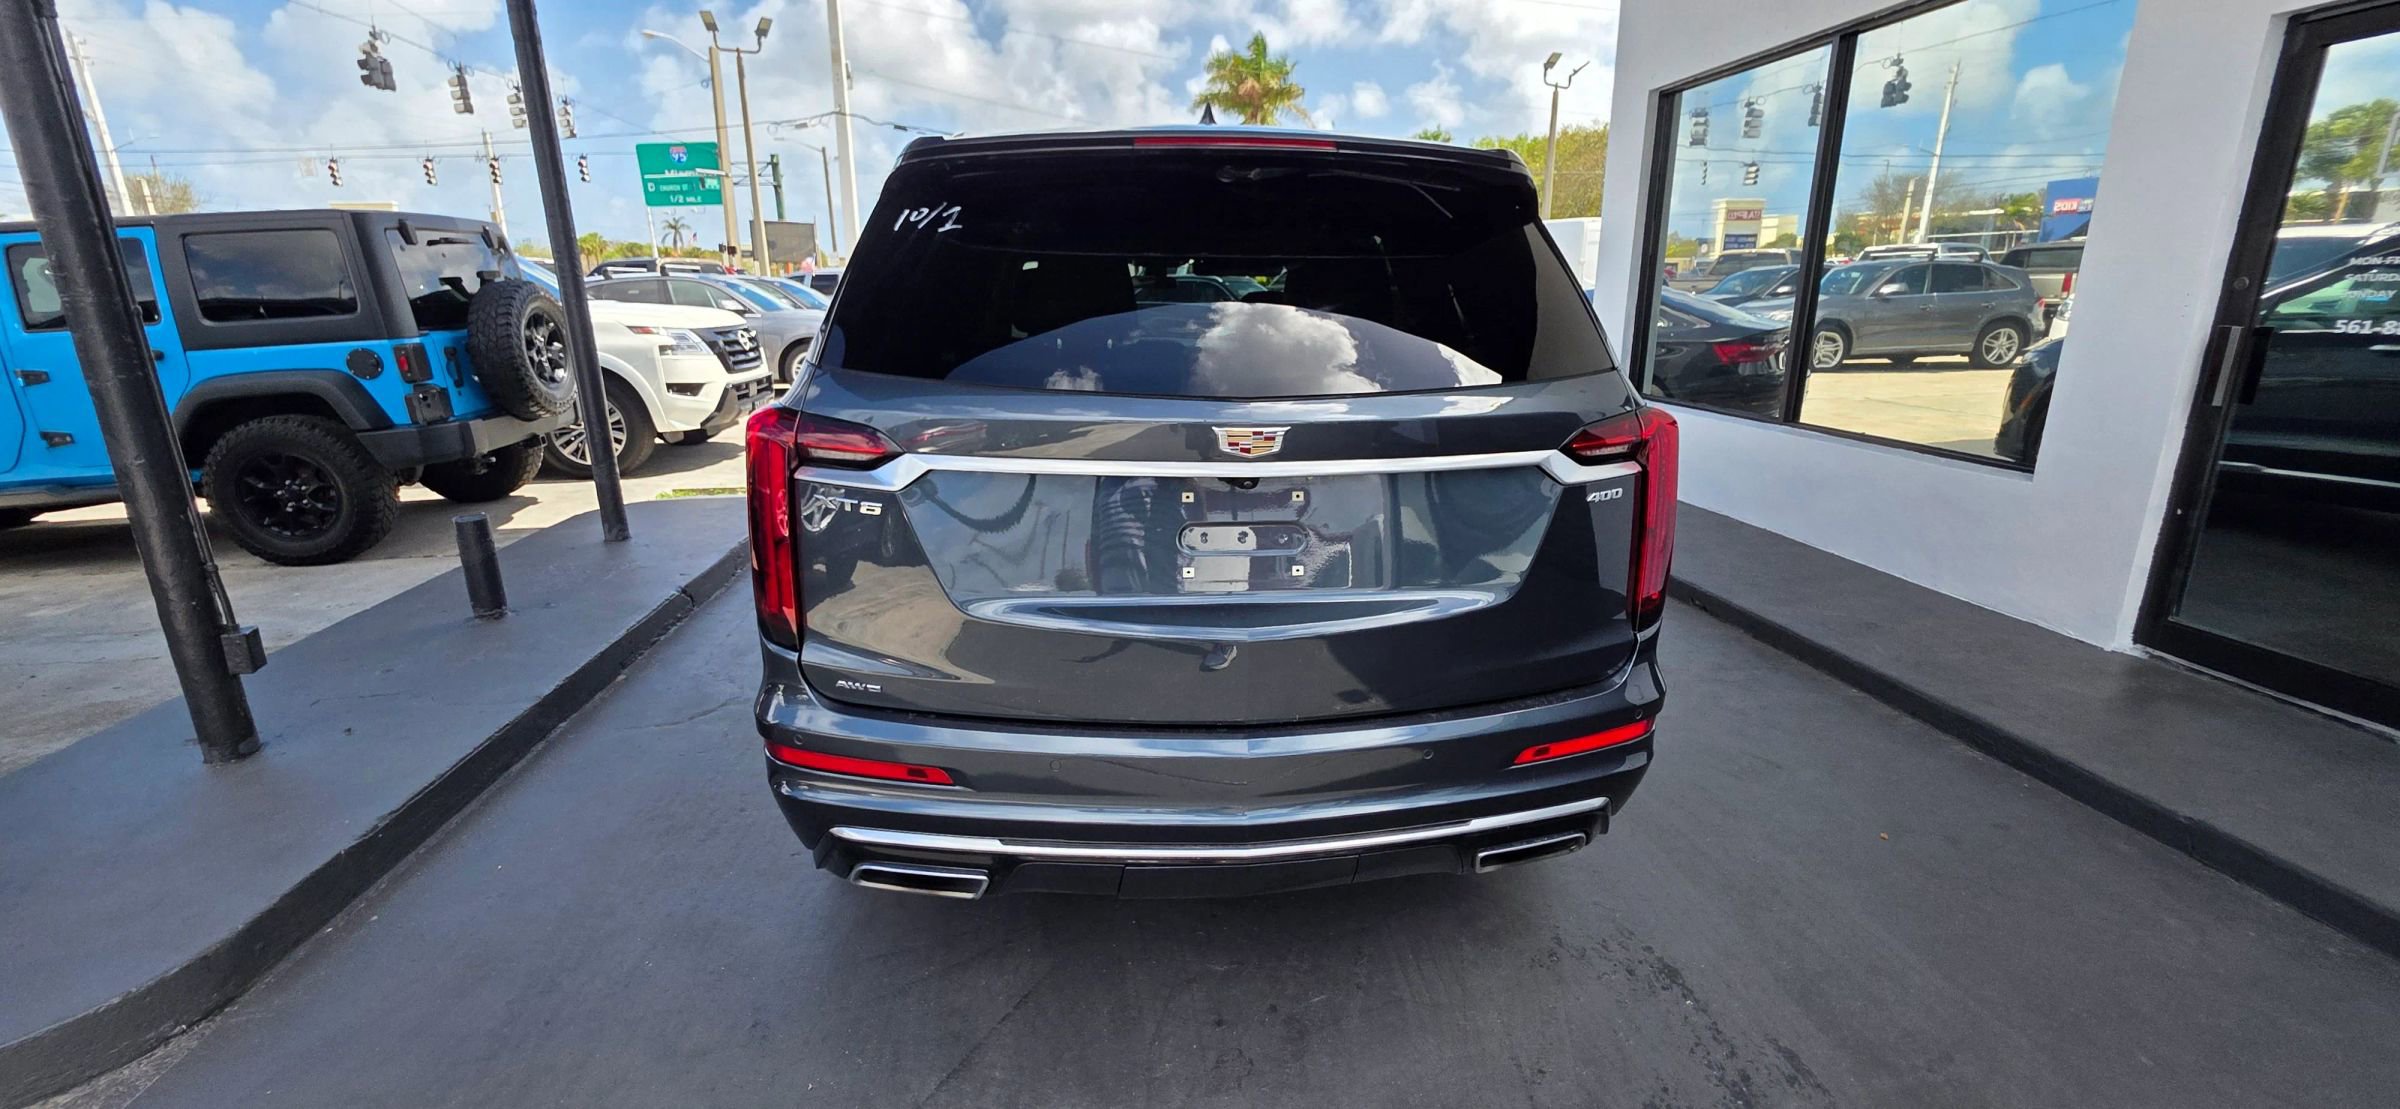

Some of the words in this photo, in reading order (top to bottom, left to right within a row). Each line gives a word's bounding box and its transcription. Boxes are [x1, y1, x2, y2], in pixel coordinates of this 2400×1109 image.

[669, 195, 684, 203] 1/2
[893, 202, 964, 232] 10/1
[2344, 273, 2400, 282] SATURD
[1585, 487, 1624, 503] 400
[803, 494, 883, 516] XT6
